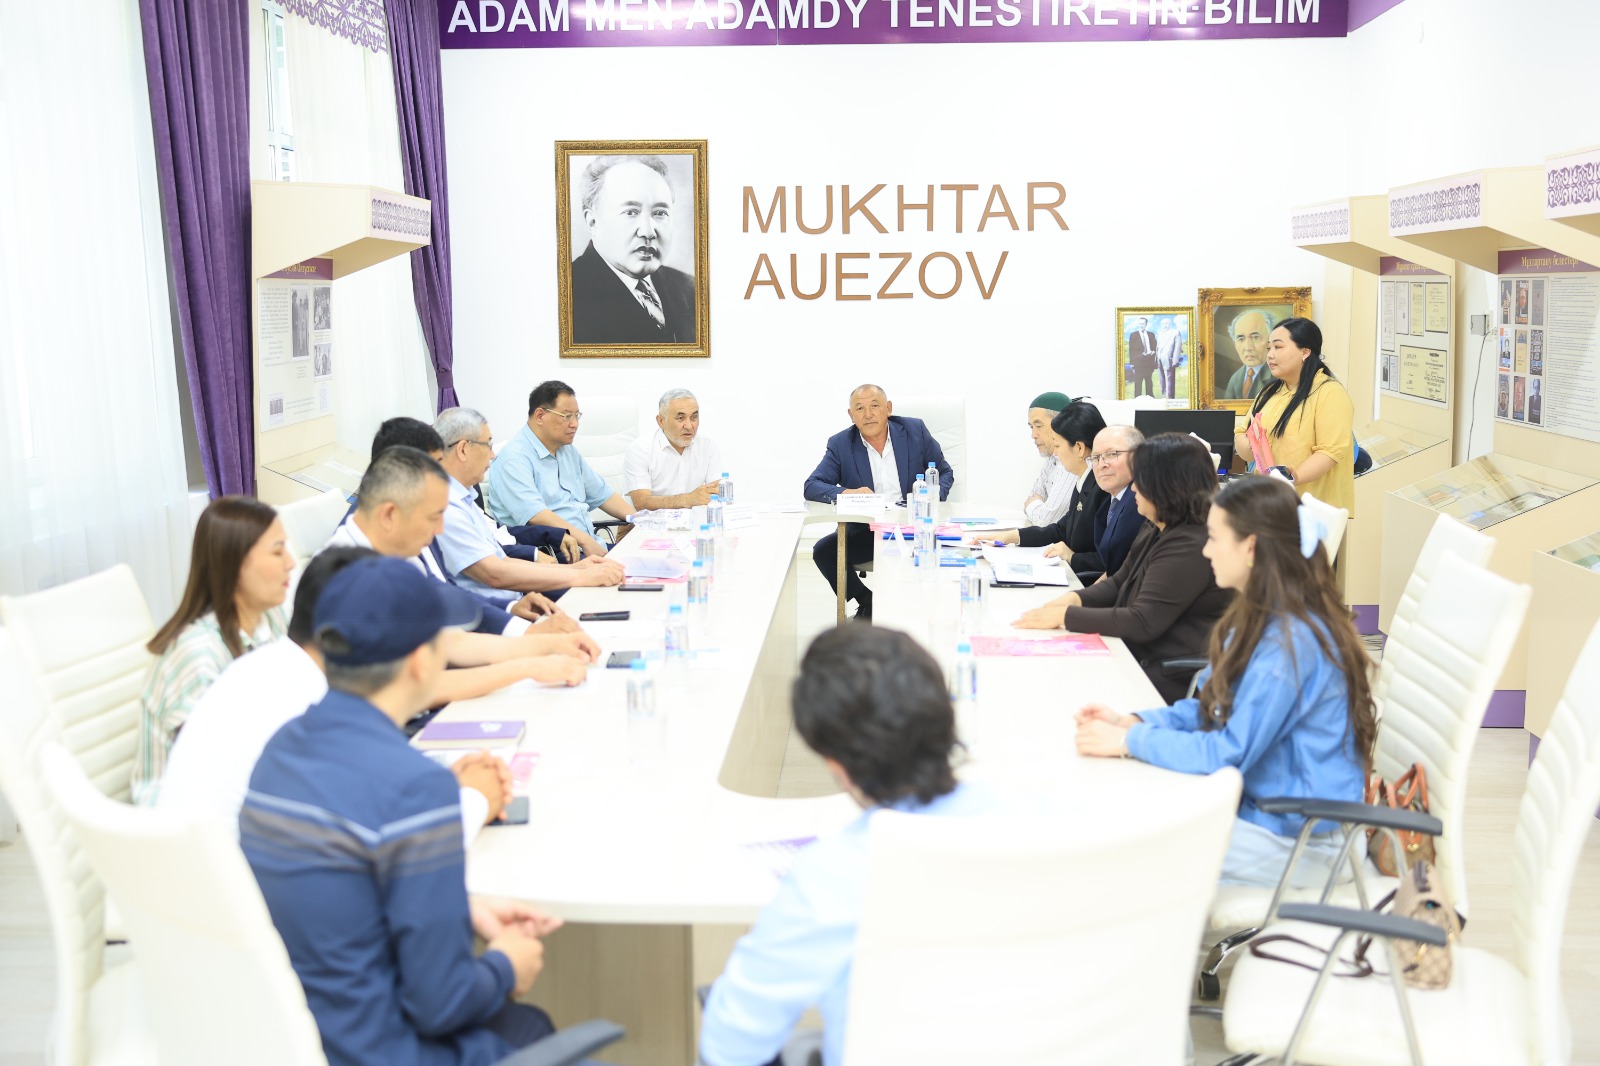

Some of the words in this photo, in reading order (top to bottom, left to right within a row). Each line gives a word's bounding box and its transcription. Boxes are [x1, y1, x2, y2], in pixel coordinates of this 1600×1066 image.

[447, 0, 570, 33] ADAM
[585, 0, 673, 31] MEN
[685, 0, 865, 30] ADAMDY
[742, 181, 1070, 235] MUKHTAR
[743, 250, 1010, 301] AUEZOV
